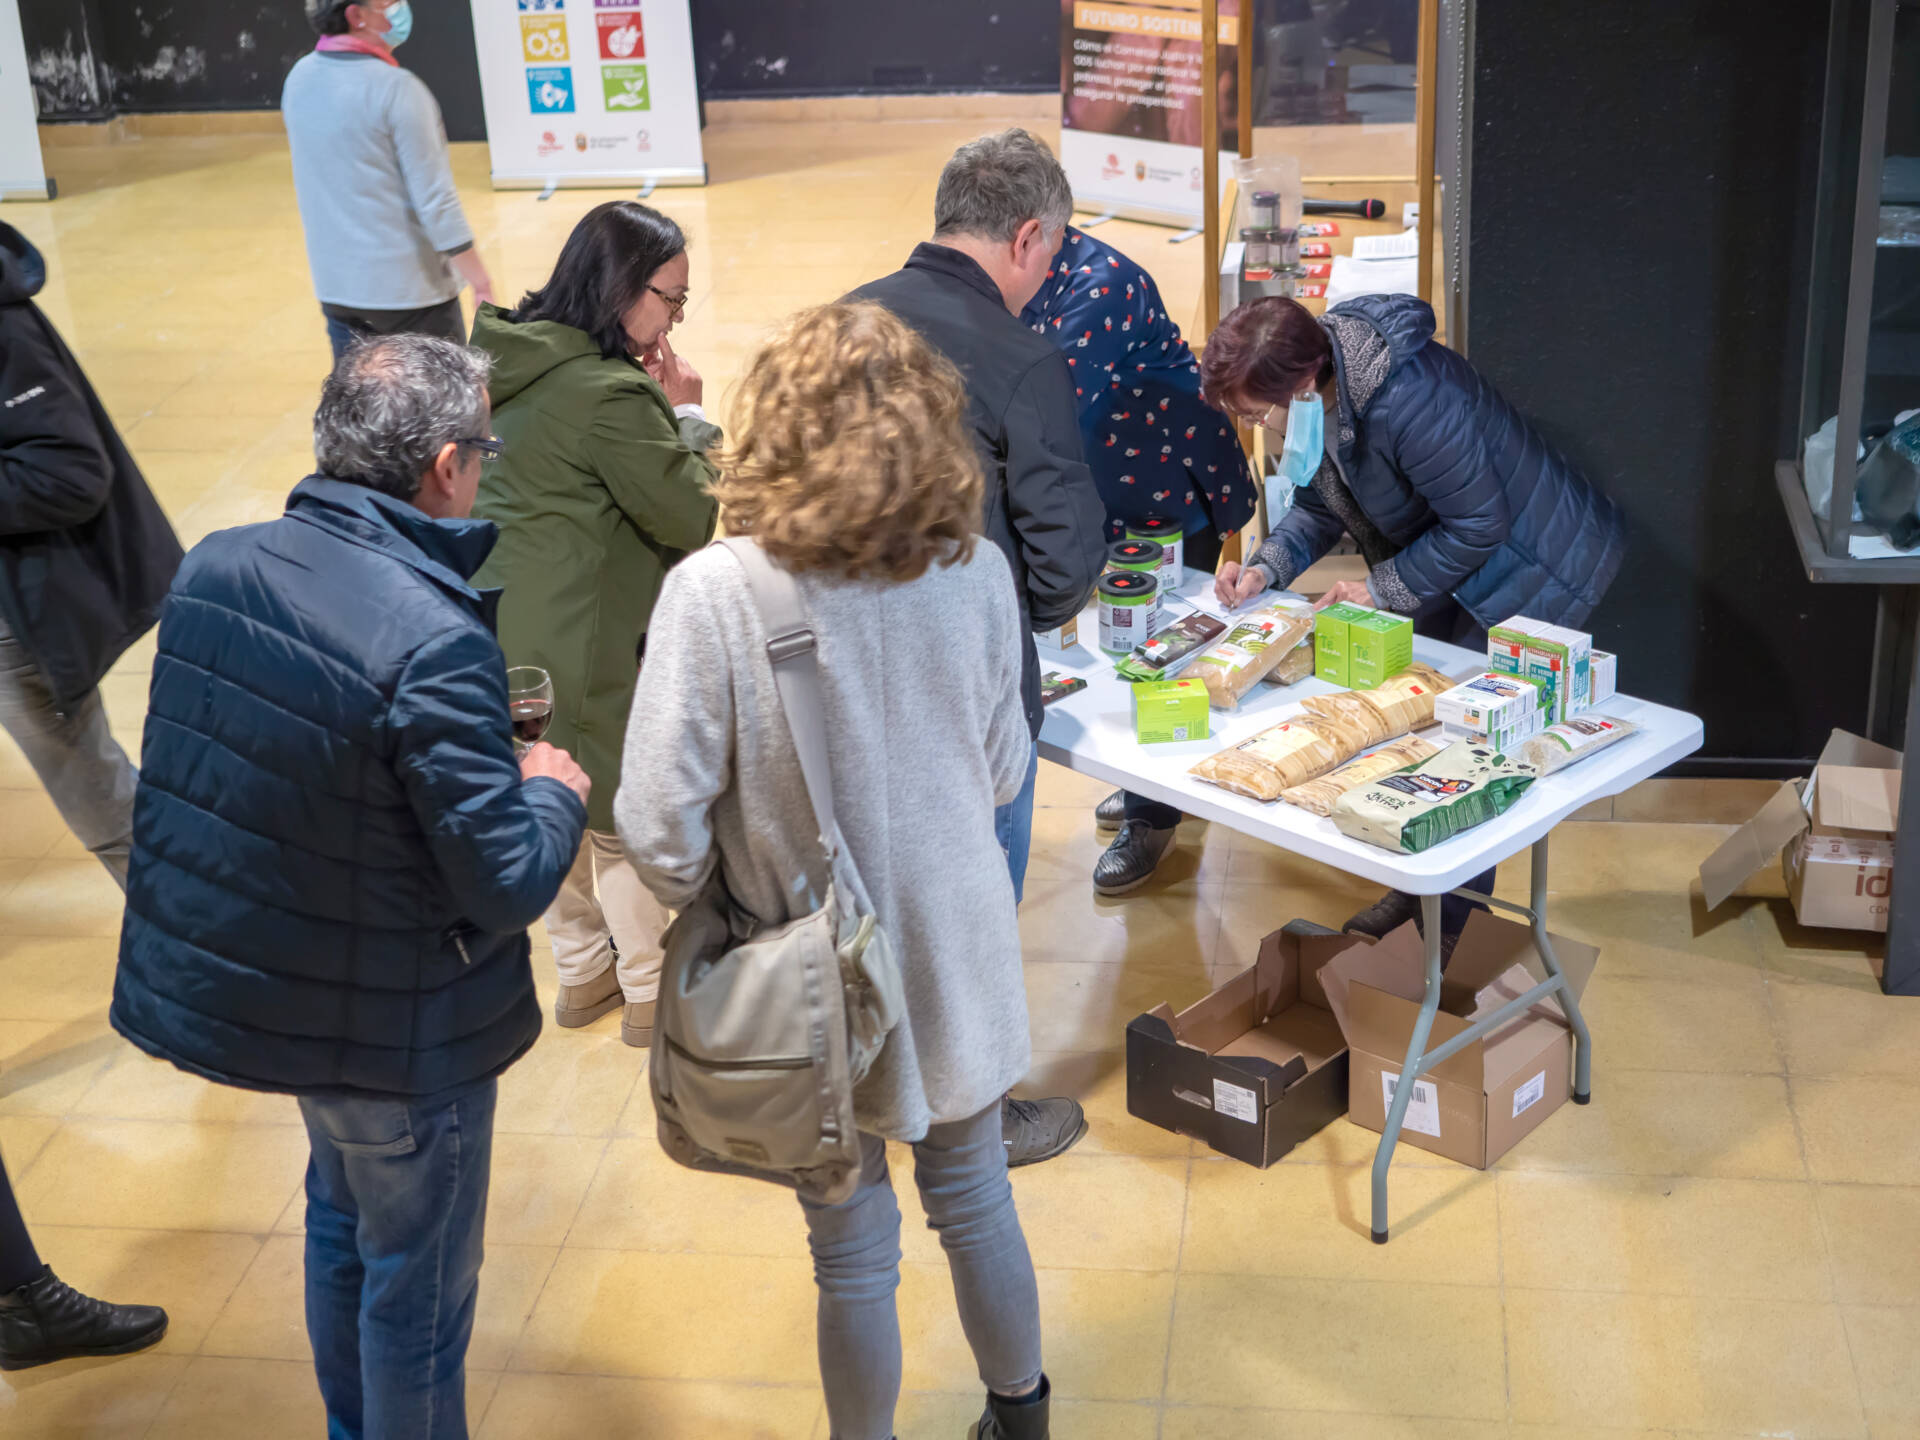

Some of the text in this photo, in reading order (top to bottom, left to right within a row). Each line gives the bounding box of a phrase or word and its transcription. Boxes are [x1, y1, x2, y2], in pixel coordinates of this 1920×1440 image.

[1081, 9, 1229, 38] FUTURO SOSTENE
[1074, 38, 1101, 52] Cómo
[1103, 43, 1112, 54] el
[1113, 43, 1159, 59] Comercio
[1074, 54, 1093, 67] ODS
[1127, 62, 1144, 74] por
[1145, 65, 1188, 78] erradicar
[1074, 87, 1114, 102] asegurar
[1116, 91, 1126, 102] la
[1113, 76, 1153, 92] proteger
[1155, 81, 1164, 91] el
